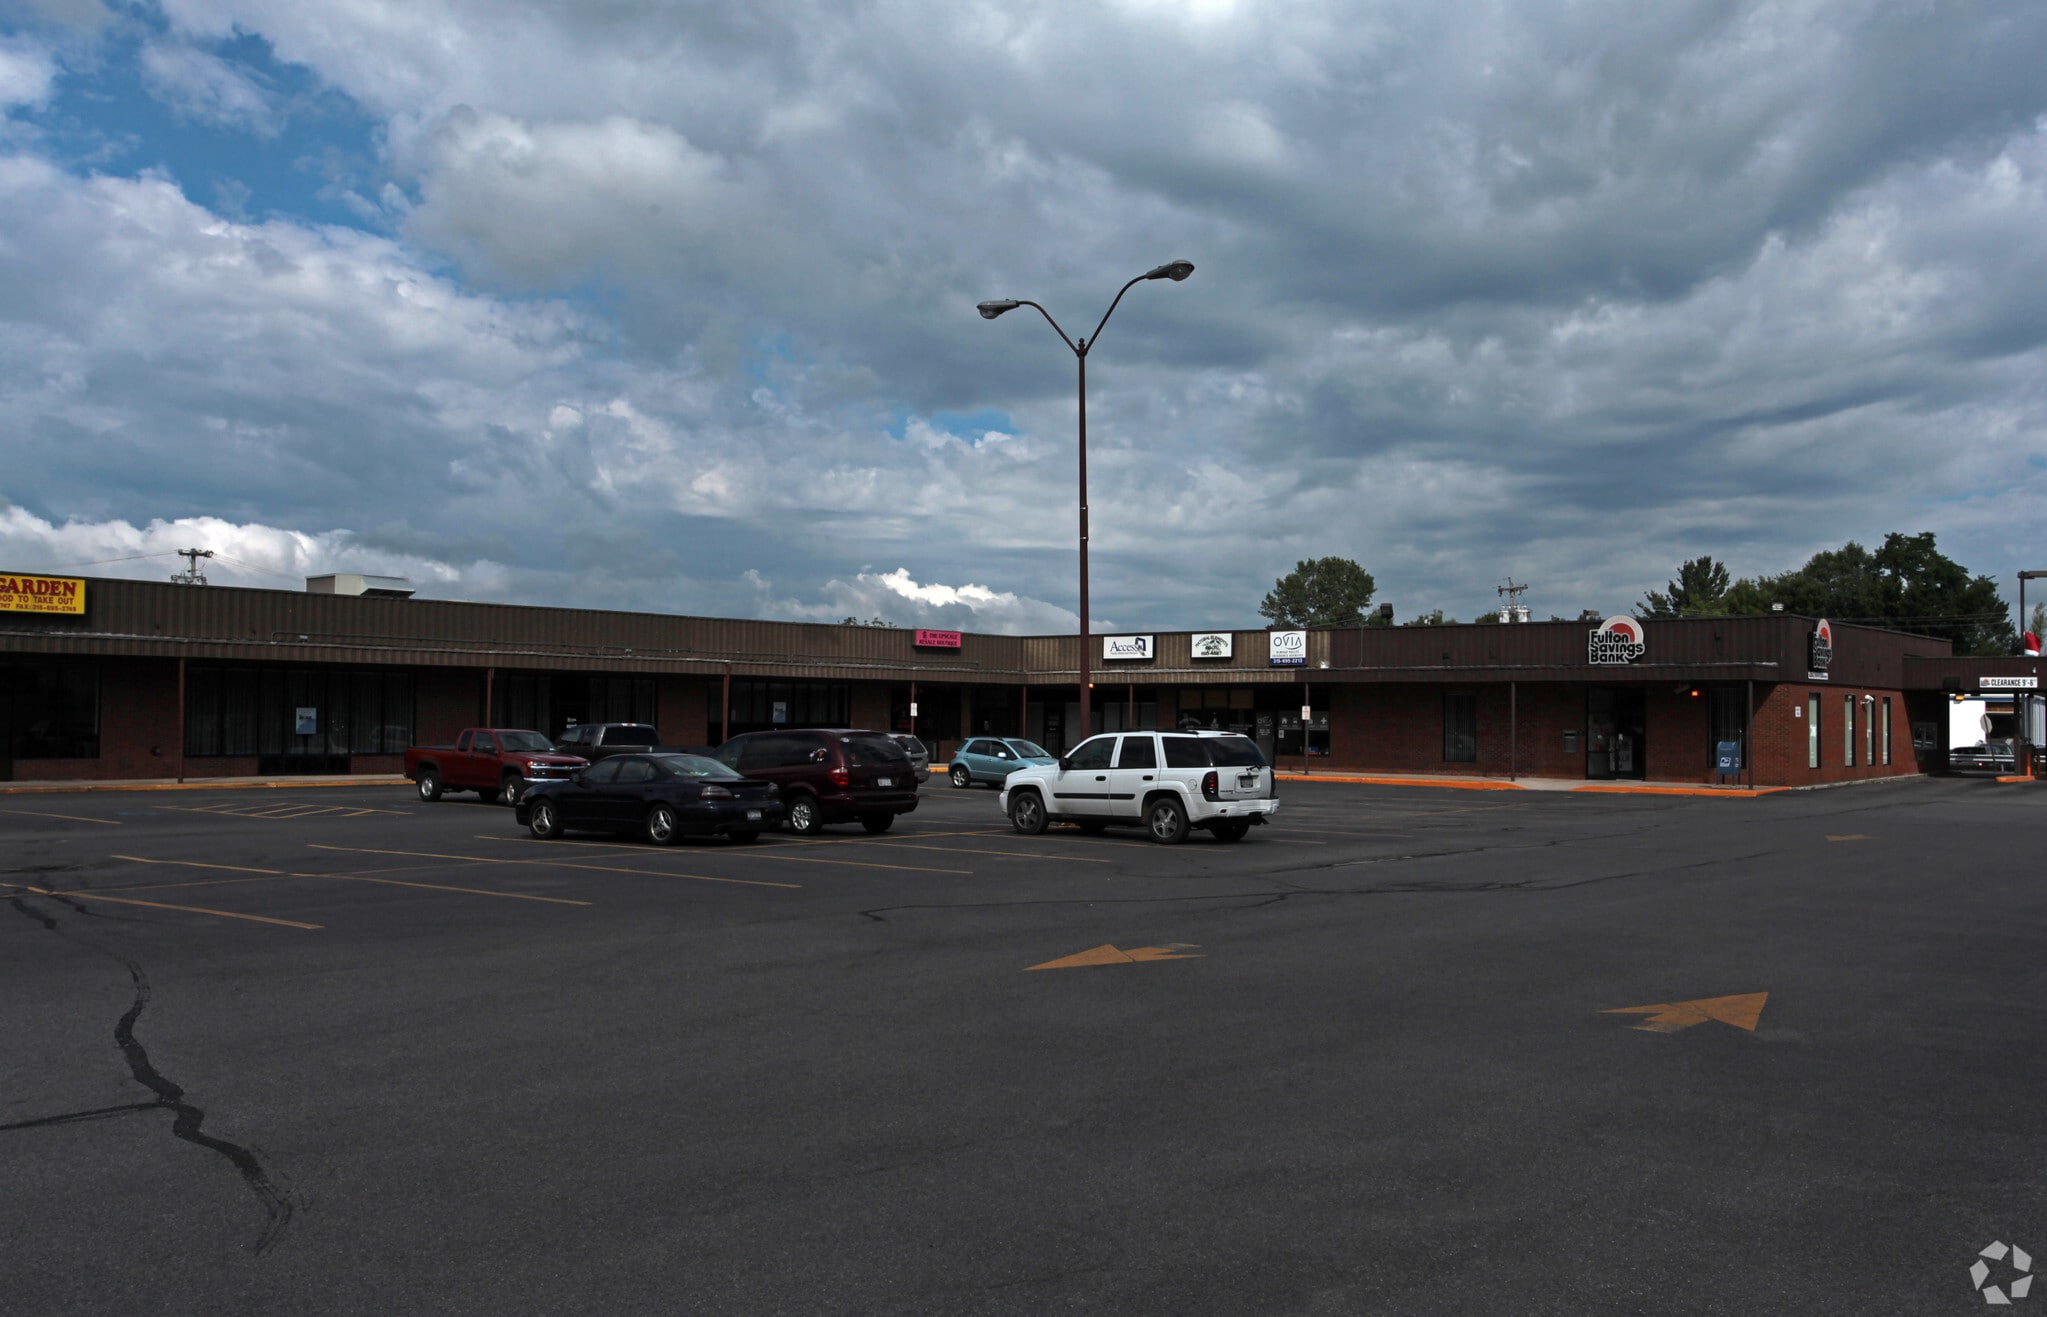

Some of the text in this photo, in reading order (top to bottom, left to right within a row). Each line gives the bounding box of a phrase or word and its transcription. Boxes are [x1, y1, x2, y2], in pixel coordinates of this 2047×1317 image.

[0, 577, 76, 597] GARDEN
[17, 595, 29, 603] TO
[33, 596, 54, 605] TAKE
[57, 597, 74, 605] OUT
[1273, 634, 1302, 648] OVIA
[1591, 630, 1629, 643] Fulton
[1110, 641, 1140, 652] Access
[1590, 643, 1643, 656] Savings
[1591, 652, 1626, 663] Bank
